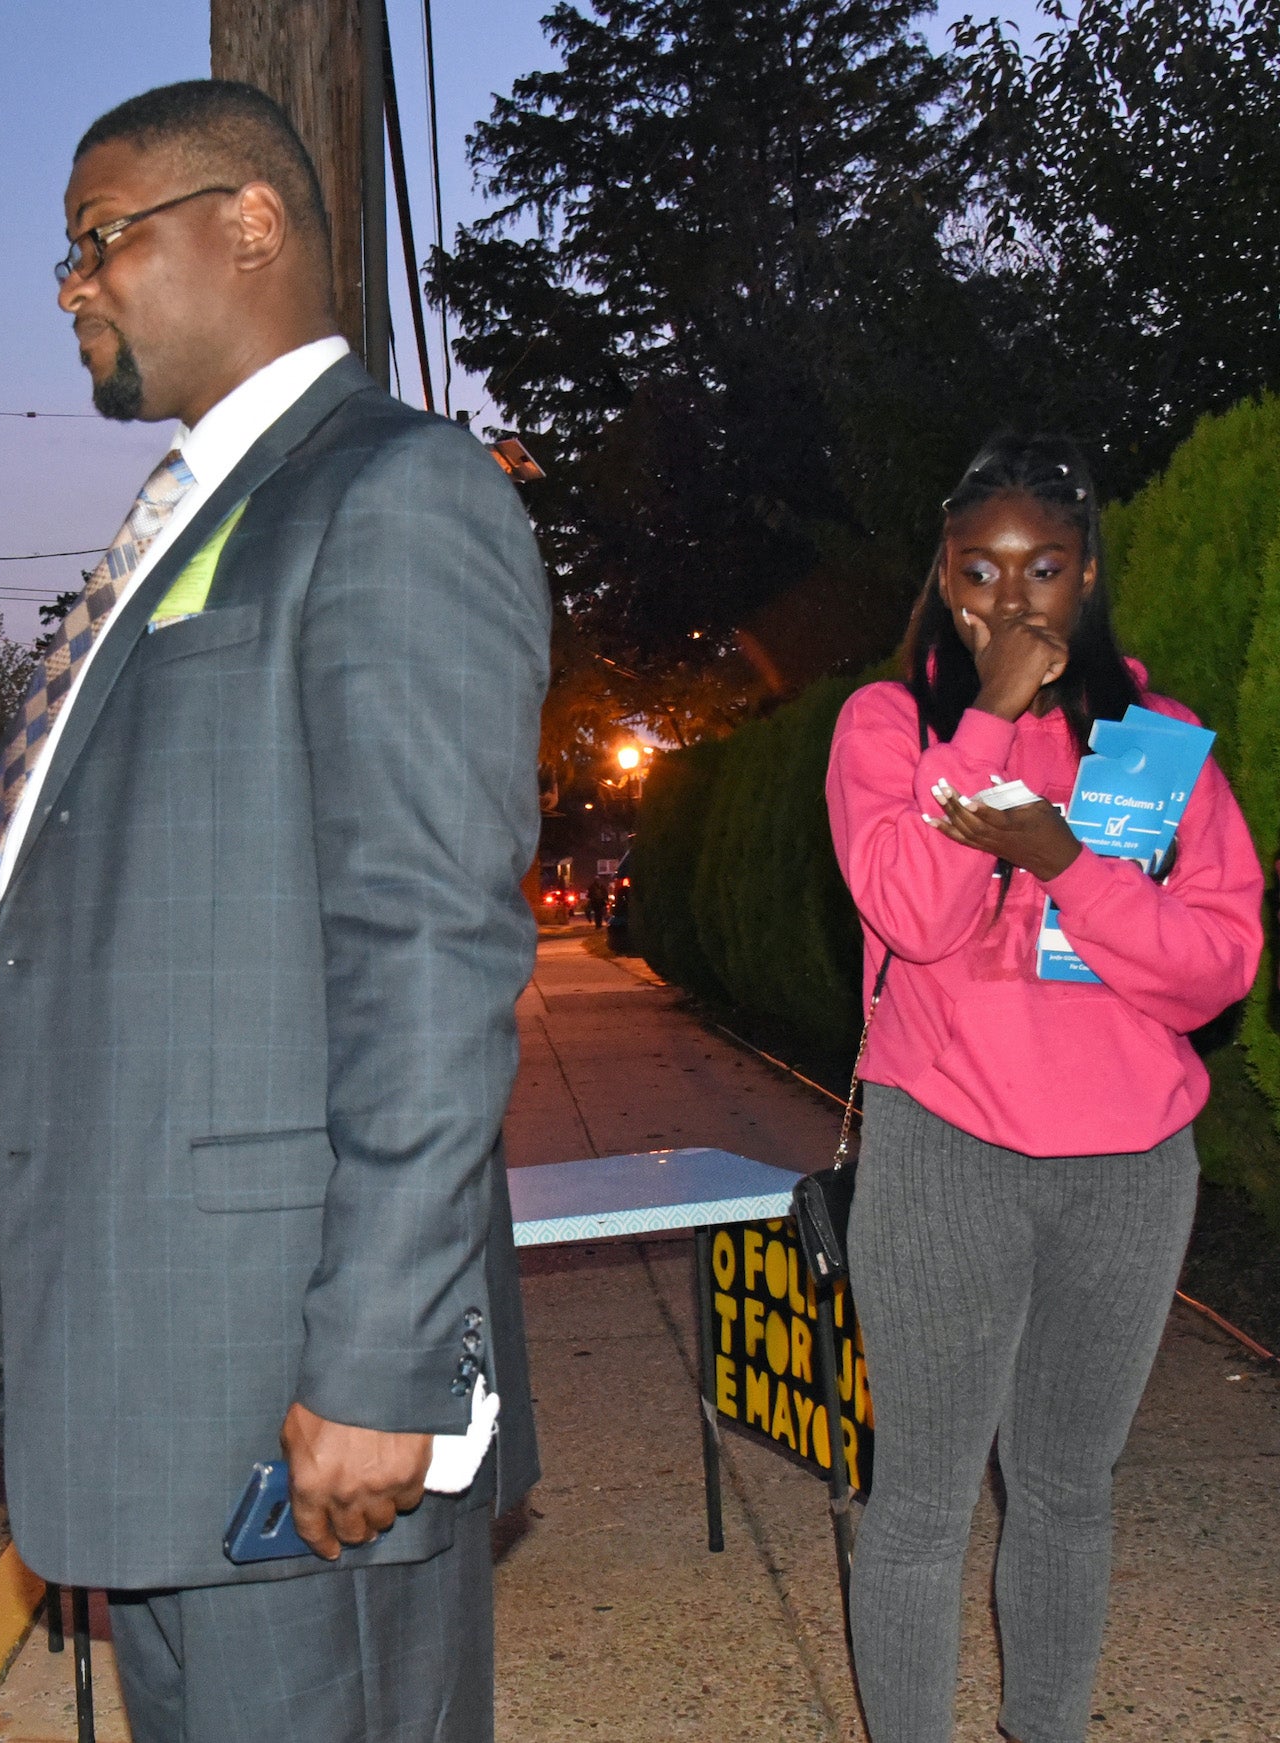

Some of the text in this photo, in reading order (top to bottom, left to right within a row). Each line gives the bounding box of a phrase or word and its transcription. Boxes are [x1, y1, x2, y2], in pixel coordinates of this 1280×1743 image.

[1081, 791, 1112, 805] VOTE
[1114, 795, 1154, 810] Column
[1155, 801, 1164, 811] 3
[1176, 792, 1185, 802] 3
[744, 1297, 812, 1384] FOR
[746, 1364, 861, 1490] MAYOR
